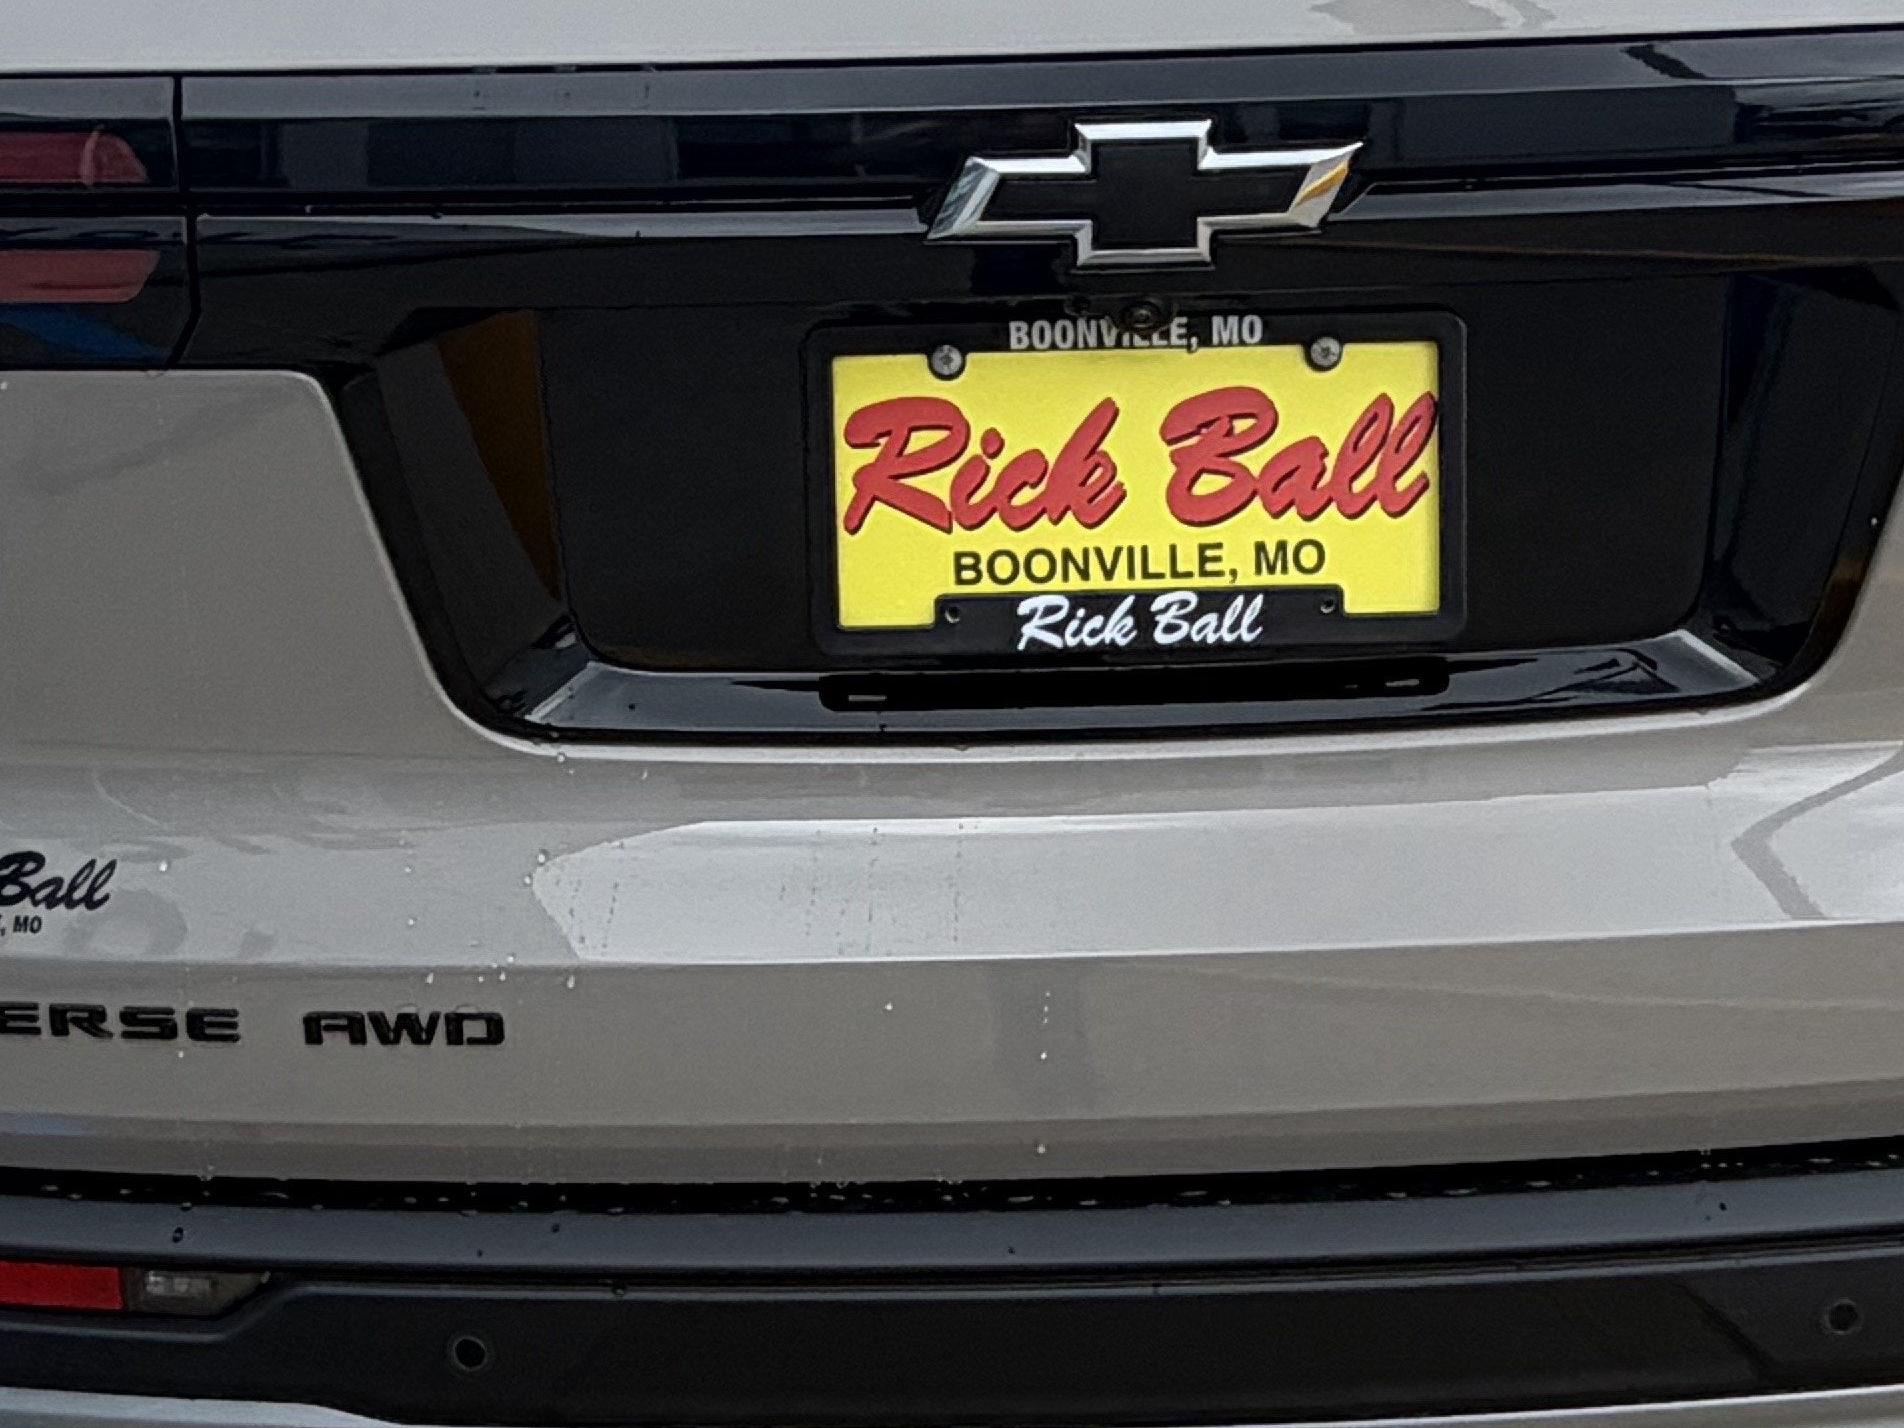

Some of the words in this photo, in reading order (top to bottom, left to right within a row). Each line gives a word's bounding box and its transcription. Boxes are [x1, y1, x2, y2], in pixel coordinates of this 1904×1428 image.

[1211, 315, 1264, 345] MO
[843, 396, 1128, 536] Rick
[1159, 385, 1439, 528] Ball
[953, 542, 1239, 586] BOONVILLE,
[1253, 537, 1327, 576] MO
[1016, 592, 1138, 652] Rick
[1150, 590, 1265, 645] Ball
[13, 915, 43, 934] MO
[302, 1009, 507, 1048] AWD
